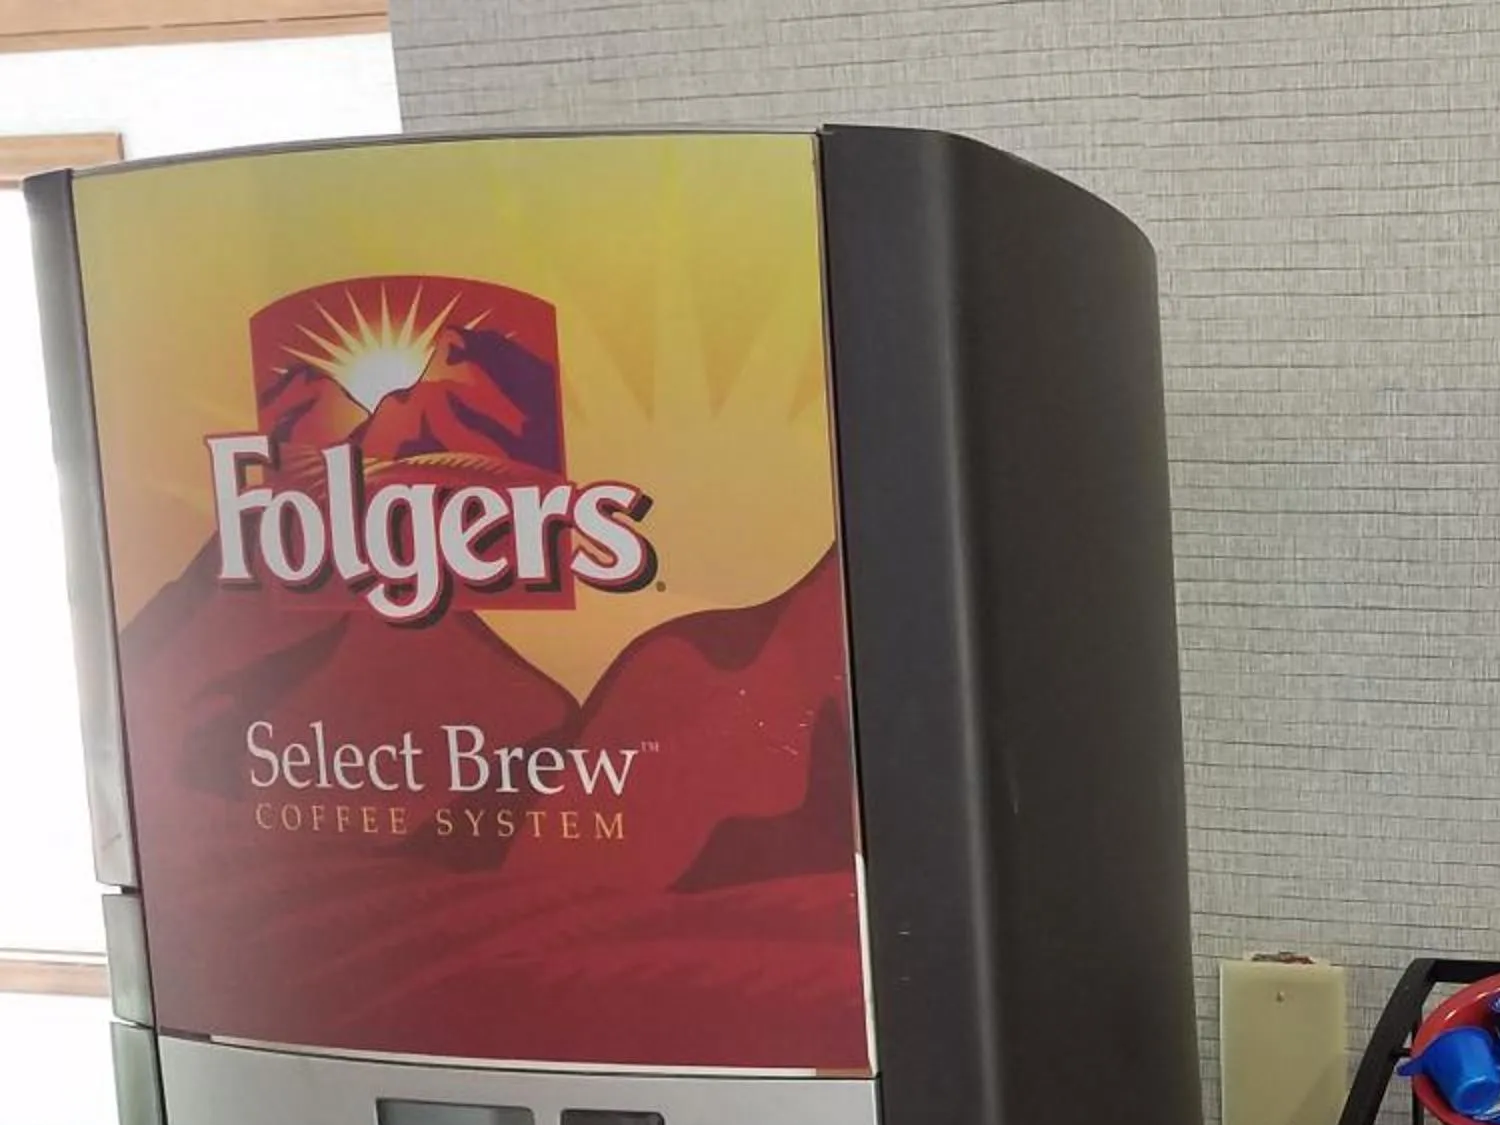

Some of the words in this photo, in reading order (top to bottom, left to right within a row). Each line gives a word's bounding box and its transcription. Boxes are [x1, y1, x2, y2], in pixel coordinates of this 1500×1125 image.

[206, 433, 655, 626] Folgers
[246, 720, 424, 790] Select
[441, 724, 639, 795] Brew
[255, 801, 408, 834] COFFEE
[436, 808, 626, 840] SYSTEM
